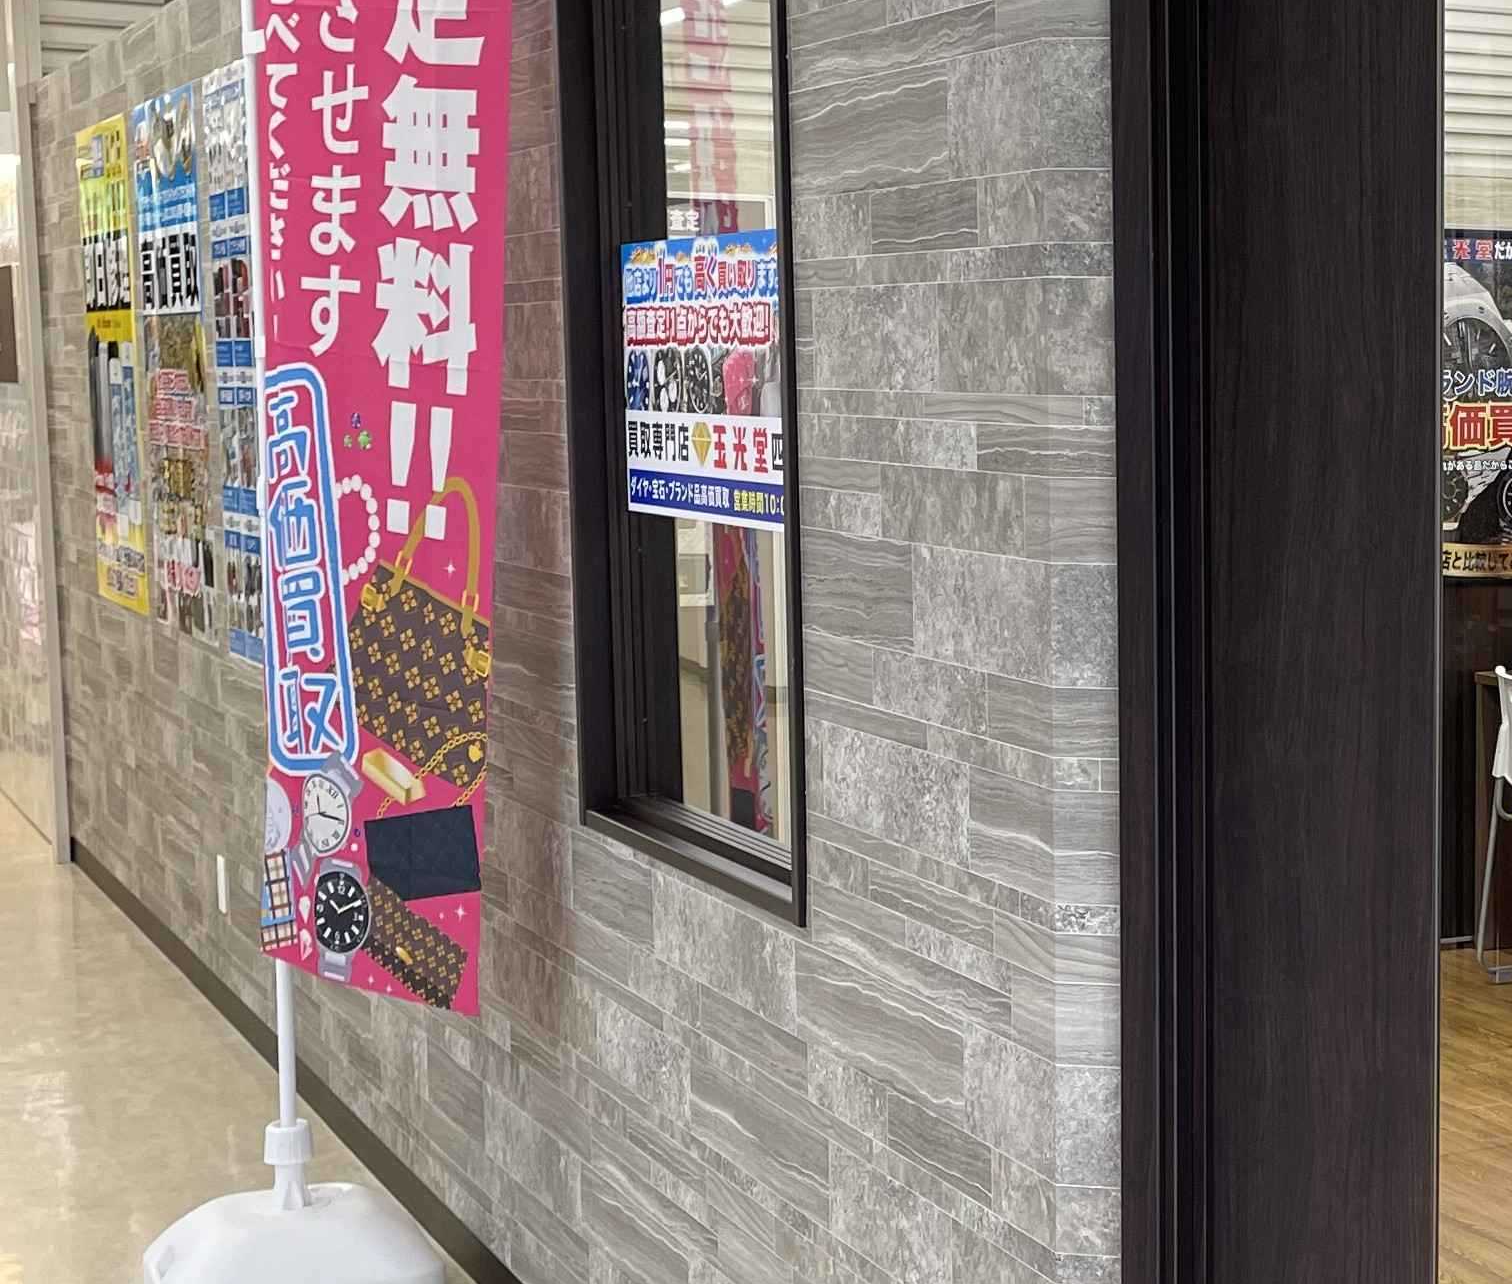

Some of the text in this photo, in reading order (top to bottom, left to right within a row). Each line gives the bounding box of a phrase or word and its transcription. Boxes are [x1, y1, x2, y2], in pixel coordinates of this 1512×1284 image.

[628, 420, 689, 462] 買取専門店
[713, 424, 769, 474] 玉光堂
